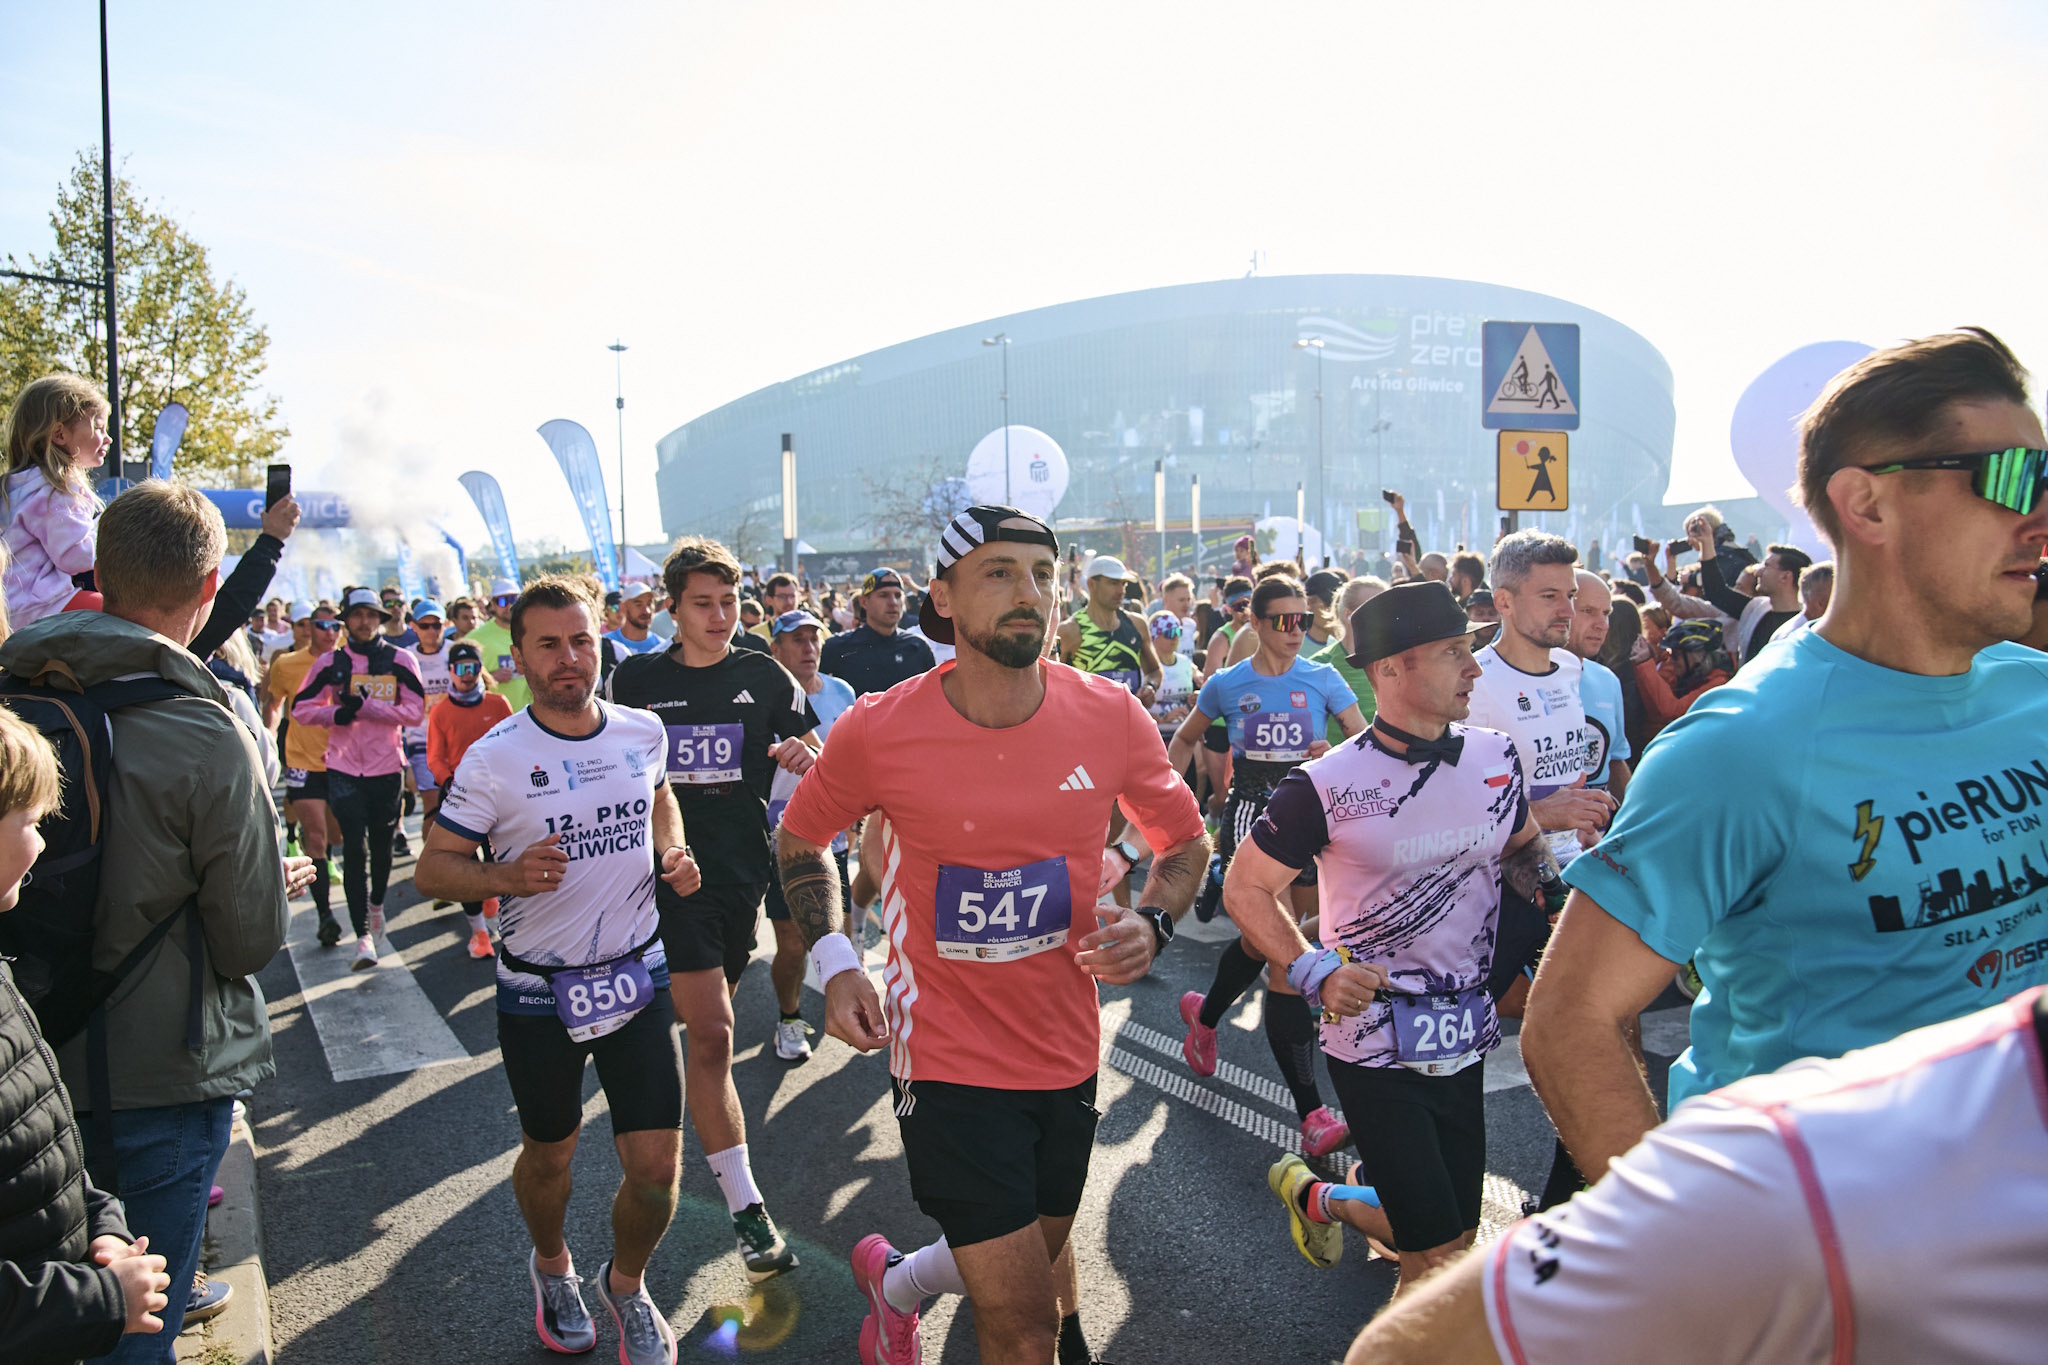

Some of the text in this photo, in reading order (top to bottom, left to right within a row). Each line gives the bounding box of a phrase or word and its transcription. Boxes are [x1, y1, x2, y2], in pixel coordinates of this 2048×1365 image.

[1410, 315, 1466, 341] pre
[1410, 344, 1483, 367] zero
[1351, 375, 1465, 393] Arena Gliwice
[674, 700, 688, 708] Bank
[1256, 723, 1303, 746] 503
[1533, 736, 1558, 754] 12.
[588, 758, 603, 766] PKO
[677, 737, 732, 766] 519
[579, 774, 606, 784] Gliwicki
[527, 791, 542, 799] Bank
[1330, 785, 1384, 806] FUTURE
[545, 799, 647, 834] 12. PKO
[559, 817, 646, 845] ÓŁMARATON
[1981, 812, 2042, 845] for FUN
[983, 880, 1022, 889] GLIWICKI
[1001, 869, 1021, 879] PKO
[957, 884, 1048, 933] 547
[1943, 926, 1990, 948] SIŁA
[568, 973, 637, 1018] 850
[1413, 1008, 1477, 1052] 264
